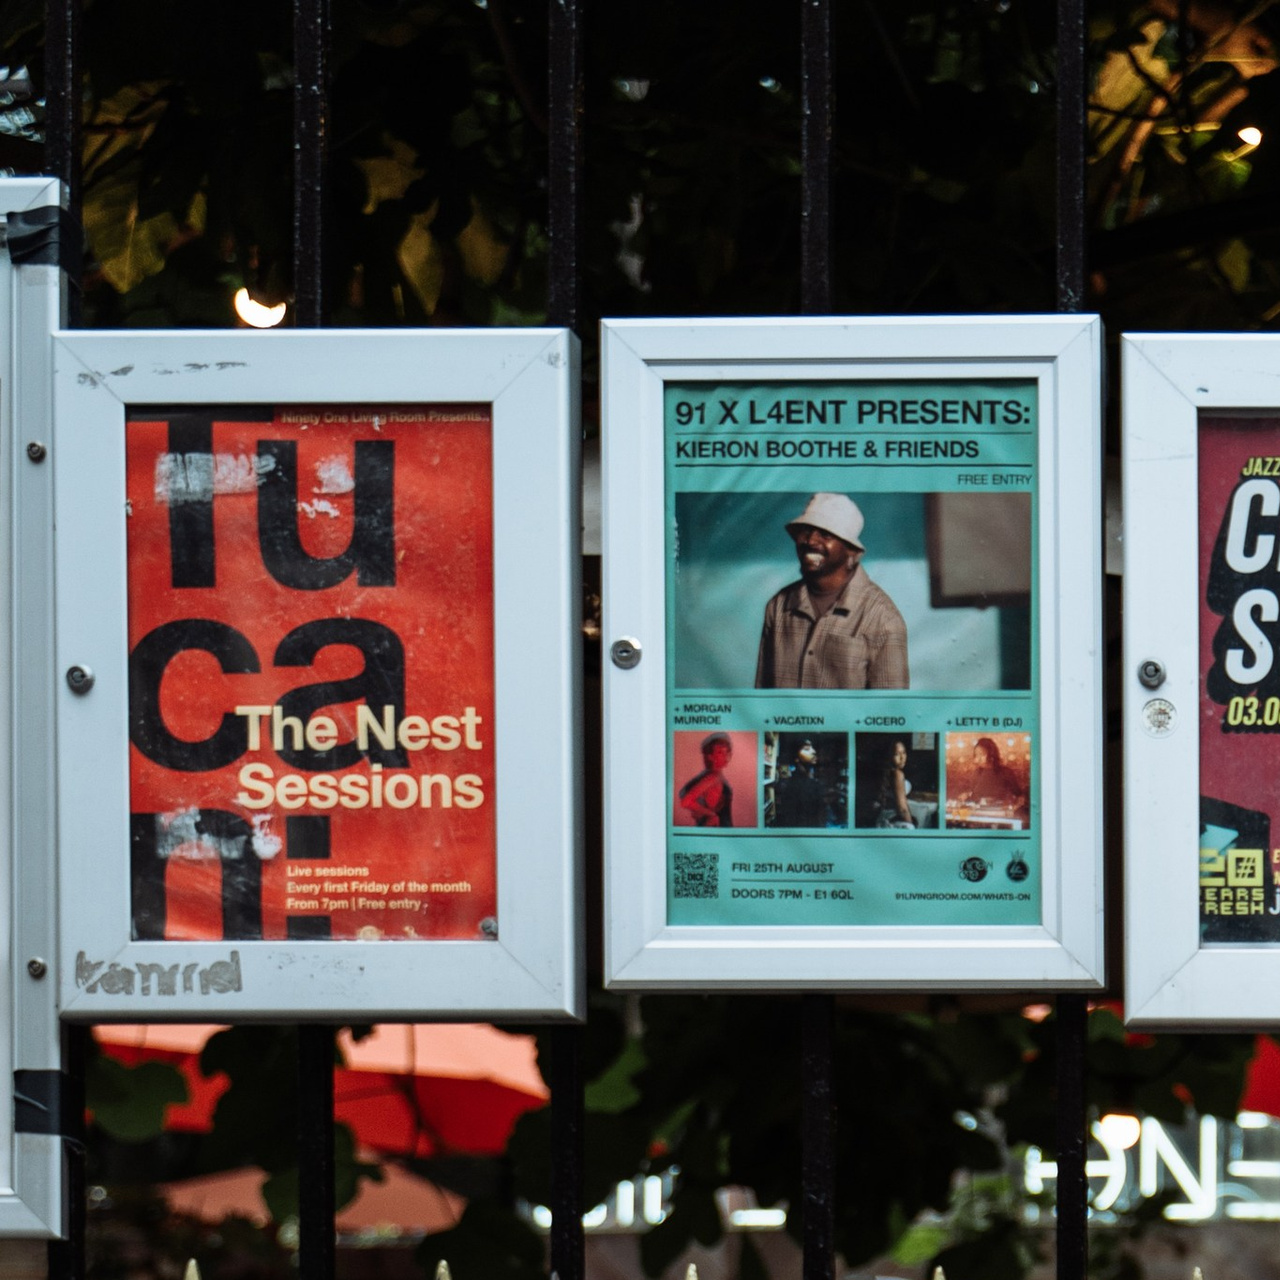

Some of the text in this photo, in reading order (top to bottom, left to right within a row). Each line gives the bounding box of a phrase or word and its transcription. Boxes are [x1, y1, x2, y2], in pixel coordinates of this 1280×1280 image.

[282, 412, 320, 425] Ninety
[324, 413, 348, 423] One
[352, 412, 386, 425] Living
[390, 412, 426, 423] Room
[676, 399, 1031, 426] 91 X L4ENT PRESENTS:
[676, 439, 979, 459] KIERON BOOTHE & FRIENDS
[957, 474, 1032, 486] FREE ENTRY
[129, 618, 410, 772] ca
[683, 703, 732, 714] MORGAN
[674, 715, 722, 726] MUNROE
[773, 715, 825, 726] VACATIXN
[864, 716, 906, 726] CICERO
[955, 717, 989, 727] LETTY
[993, 717, 1000, 727] B
[1002, 716, 1023, 728] (DJ)
[236, 706, 483, 751] The Nest
[236, 763, 484, 810] Sessions
[287, 866, 369, 877] Live sessions
[732, 862, 835, 874] FRI 25TH AUGUST
[287, 881, 471, 895] Every first Friday of the month
[732, 888, 776, 900] DOORS
[779, 888, 802, 900] 7PM
[814, 889, 828, 900] E1
[830, 888, 854, 901] 6QL
[1200, 888, 1264, 901] EARS
[287, 898, 319, 910] From
[324, 898, 349, 912] 7pm
[358, 898, 387, 910] Free
[389, 898, 422, 912] entry
[1200, 902, 1264, 915] RESH
